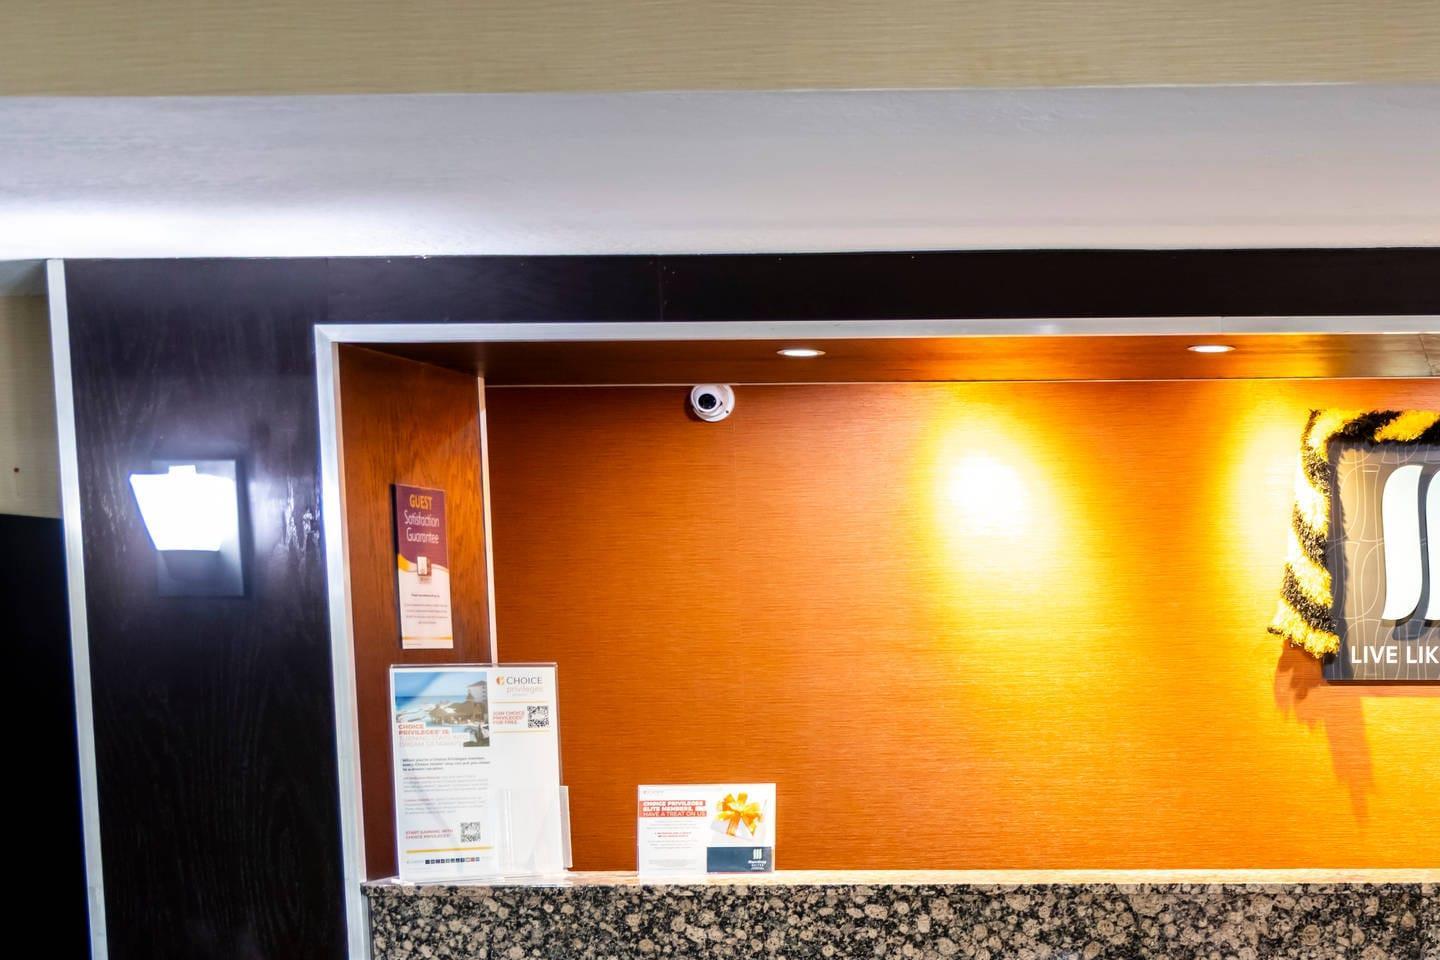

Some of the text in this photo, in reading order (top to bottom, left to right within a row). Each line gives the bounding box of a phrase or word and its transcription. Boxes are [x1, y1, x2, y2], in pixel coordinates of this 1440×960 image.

[409, 494, 432, 510] GUEST
[404, 509, 440, 527] Satisfaction
[406, 527, 439, 544] Guarantee
[1351, 646, 1398, 664] LIVE
[506, 676, 542, 685] CHOICE
